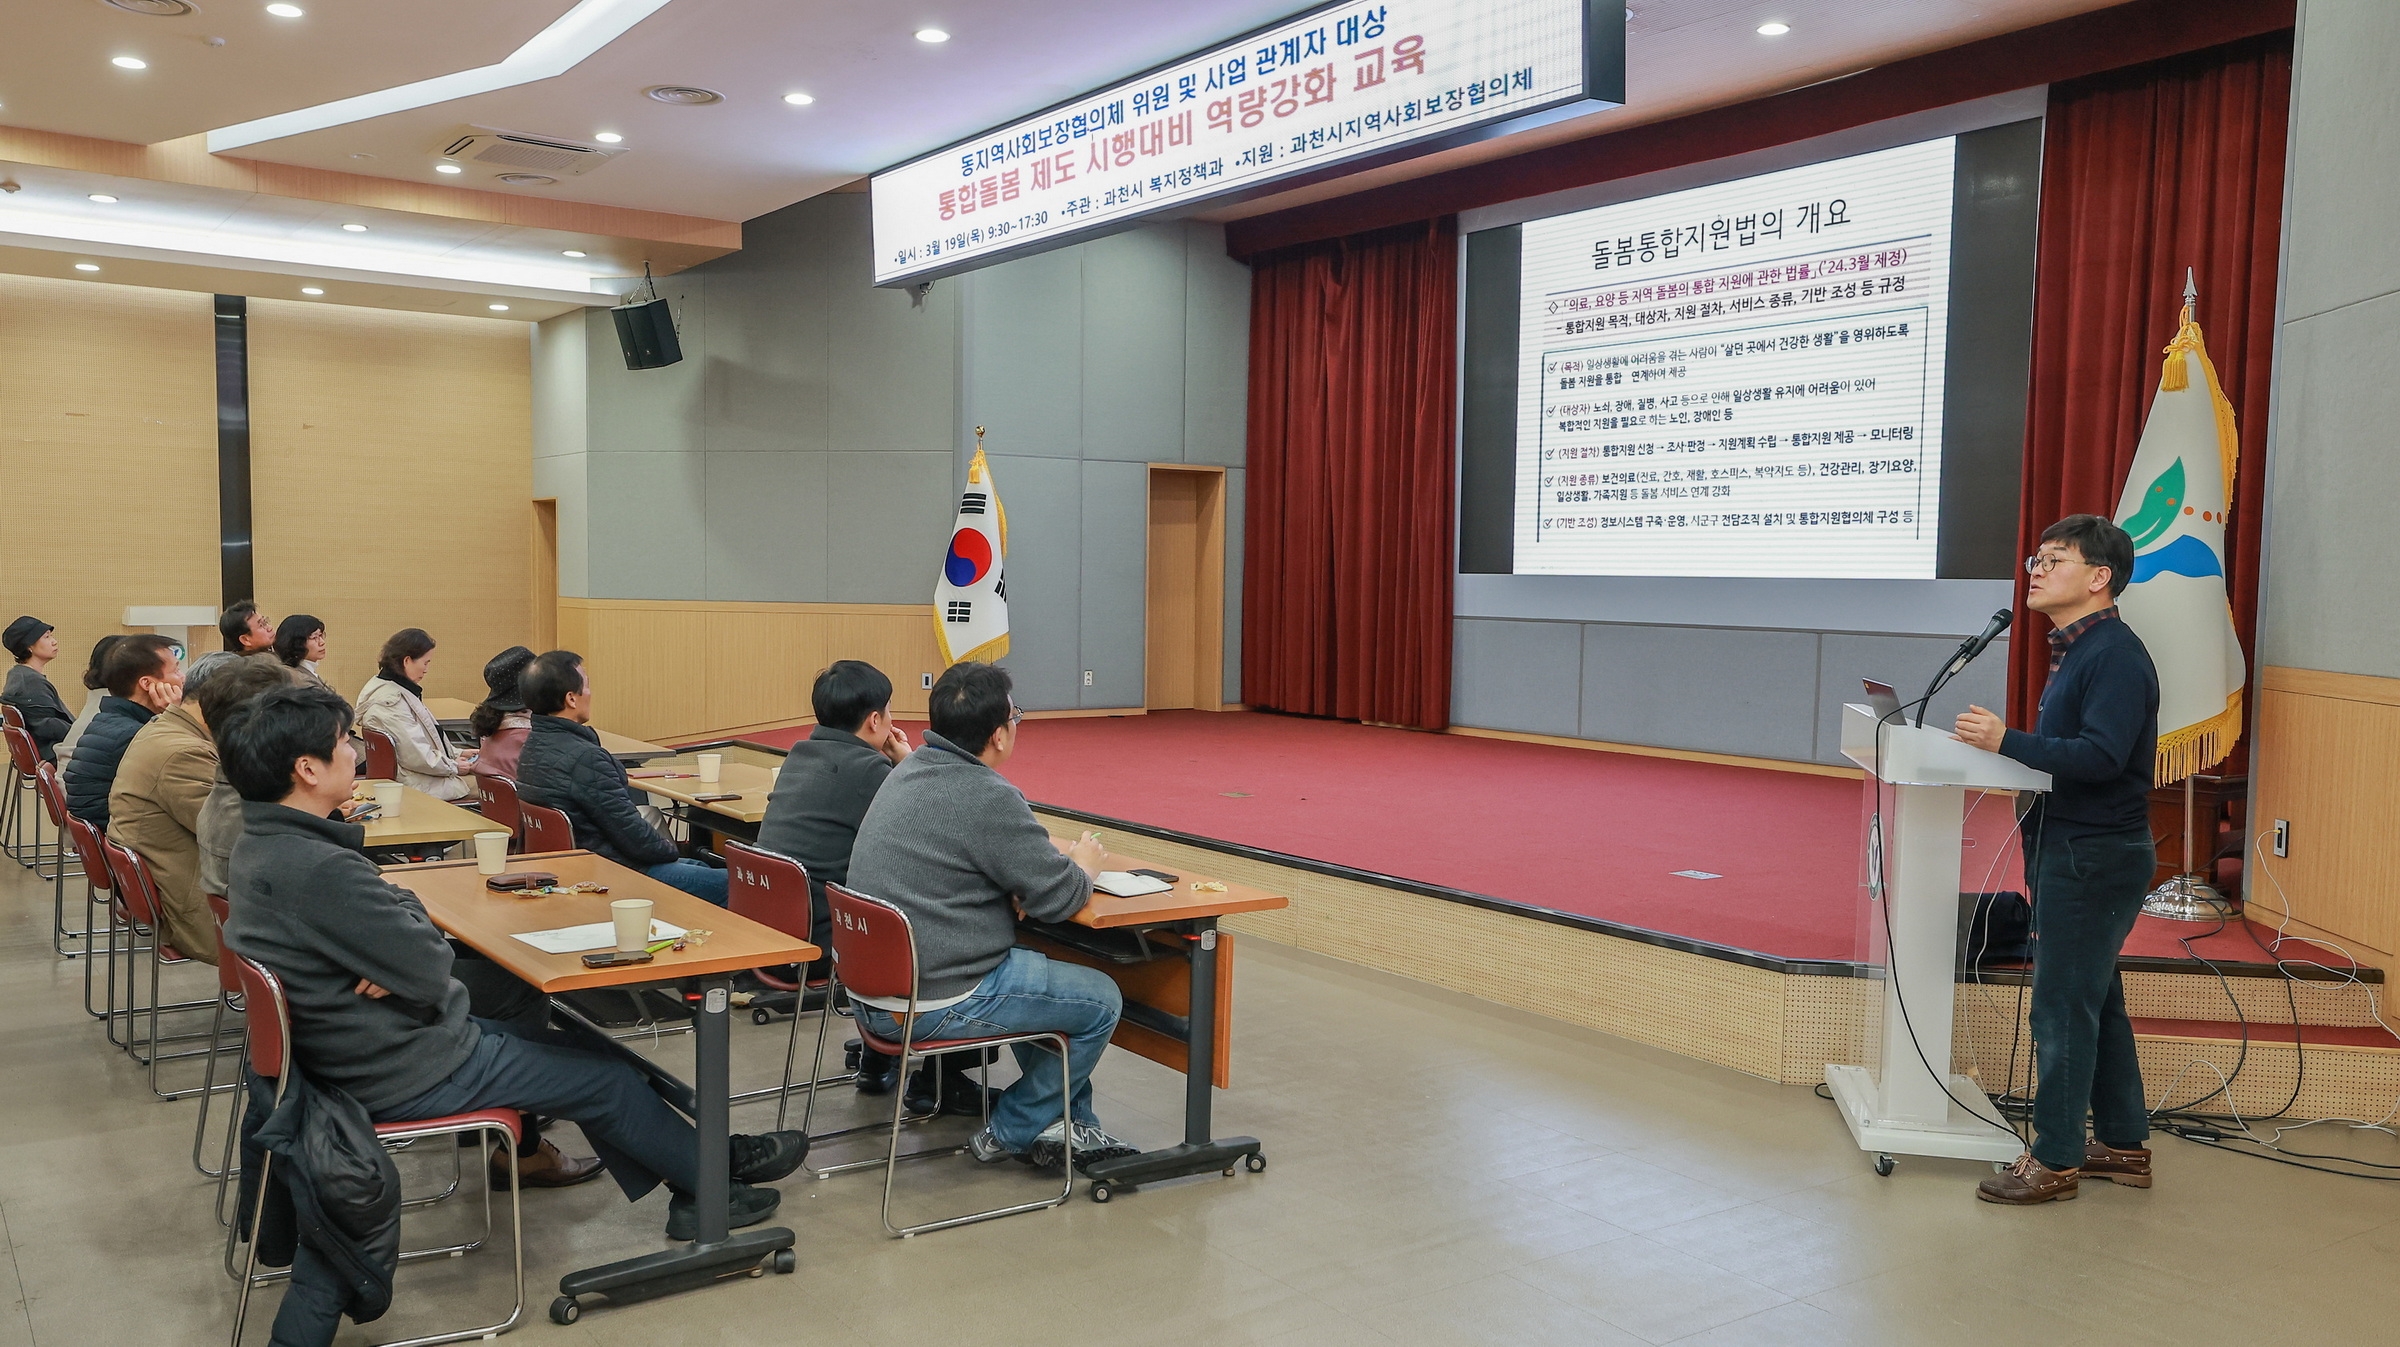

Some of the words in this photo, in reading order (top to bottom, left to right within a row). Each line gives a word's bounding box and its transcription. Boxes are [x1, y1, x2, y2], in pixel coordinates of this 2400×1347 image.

[962, 100, 1123, 176] 동지역사회보장협의체
[1133, 83, 1169, 116] 위원
[1179, 74, 1196, 103] 및
[1205, 56, 1245, 92] 사업
[1256, 27, 1326, 75] 관계자
[1337, 5, 1387, 46] 대상
[939, 168, 1020, 220] 통합돌봄
[1031, 150, 1075, 190] 제도
[1087, 110, 1192, 173] 시행대비
[1207, 63, 1336, 133] 역량강화
[1354, 35, 1425, 91] 교육
[927, 241, 940, 256] 3월
[946, 229, 984, 250] 19일(목)
[988, 211, 1047, 239] 9:30~17:30
[1104, 181, 1142, 205] 과천시
[1150, 158, 1223, 192] 복지정책과
[1290, 67, 1532, 153] 과천시지역사회보장협의체
[1592, 209, 1782, 269] 돌봄통합지원법의
[1797, 199, 1850, 233] 개요
[1595, 293, 1615, 307] 요양
[1618, 291, 1629, 305] 등
[1632, 288, 1652, 302] 지역
[1656, 282, 1688, 300] 돌봄의
[1692, 278, 1715, 294] 통합
[1719, 273, 1753, 290] 지원에
[1757, 268, 1781, 285] 관한
[1874, 248, 1907, 268] 제정)
[1566, 317, 1604, 334] 통합지원
[1608, 314, 1631, 328] 목적,
[1636, 309, 1670, 325] 대상자,
[1675, 305, 1696, 320] 지원
[1700, 302, 1725, 317] 절차,
[1730, 297, 1765, 312] 서비스
[1769, 292, 1796, 308] 종류,
[1802, 287, 1827, 303] 기반
[1831, 283, 1855, 298] 조성
[1861, 280, 1874, 296] 등
[1879, 276, 1904, 294] 규정
[1561, 361, 1583, 372] (목적)
[1587, 356, 1628, 370] 일상생활에
[1631, 351, 1666, 365] 어려움을
[1689, 346, 1716, 358] 사람이
[1746, 339, 1775, 353] 곳에서
[1779, 335, 1809, 350] 건강한
[1853, 323, 1909, 342] 영위하도록
[1560, 378, 1576, 389] 돌봄
[1579, 374, 1603, 387] 지원을
[1605, 372, 1622, 385] 통합
[1632, 368, 1665, 382] 연계하여
[1669, 366, 1686, 377] 제공
[1560, 404, 1590, 416] (대상자)
[1594, 402, 1612, 412] 노쇠,
[1616, 400, 1634, 412] 장애,
[1638, 398, 1657, 410] 질병,
[1660, 396, 1678, 408] 사고
[1681, 393, 1707, 406] 등으로
[1711, 391, 1729, 404] 인해
[1733, 388, 1772, 402] 일상생활
[1775, 384, 1804, 399] 유지에
[1808, 381, 1850, 396] 어려움이
[1854, 378, 1875, 391] 있어
[1559, 419, 1590, 432] 복합적인
[1594, 417, 1618, 429] 지원을
[1621, 416, 1646, 428] 필요로
[1649, 414, 1666, 425] 하는
[1670, 412, 1690, 424] 노인,
[1694, 409, 1720, 423] 장애인
[1724, 408, 1733, 420] 등
[1559, 448, 1577, 459] (지원
[1581, 447, 1599, 458] 절차)
[1603, 444, 1635, 457] 통합지원
[1638, 443, 1653, 455] 신청
[1719, 437, 1755, 450] 지원계획
[1758, 435, 1776, 448] 수립
[1791, 432, 1831, 446] 통합지원
[1834, 430, 1854, 444] 제공
[1870, 427, 1913, 441] 모니터링
[1558, 475, 1576, 486] (지원
[1580, 475, 1598, 486] 종류)
[1664, 471, 1683, 482] 간호,
[1687, 470, 1707, 481] 재활,
[1711, 468, 1751, 479] 호스피스,
[1755, 466, 1793, 478] 복약지도
[1820, 462, 1864, 476] 건강관리,
[1869, 459, 1916, 474] 장기요양,
[1594, 489, 1627, 500] 가족지원
[1631, 489, 1637, 499] 등
[1642, 488, 1657, 499] 돌봄
[1661, 487, 1687, 498] 서비스
[1691, 486, 1709, 497] 연계
[1713, 485, 1730, 497] 강화
[1557, 518, 1575, 528] (기반
[1578, 518, 1597, 528] 조성)
[1601, 517, 1643, 528] 정보시스템
[1722, 514, 1759, 526] 전담조직
[1764, 513, 1782, 525] 설치
[1786, 513, 1795, 525] 및
[1799, 511, 1873, 525] 통합지원협의체
[1877, 511, 1898, 523] 구성
[1903, 511, 1913, 523] 등
